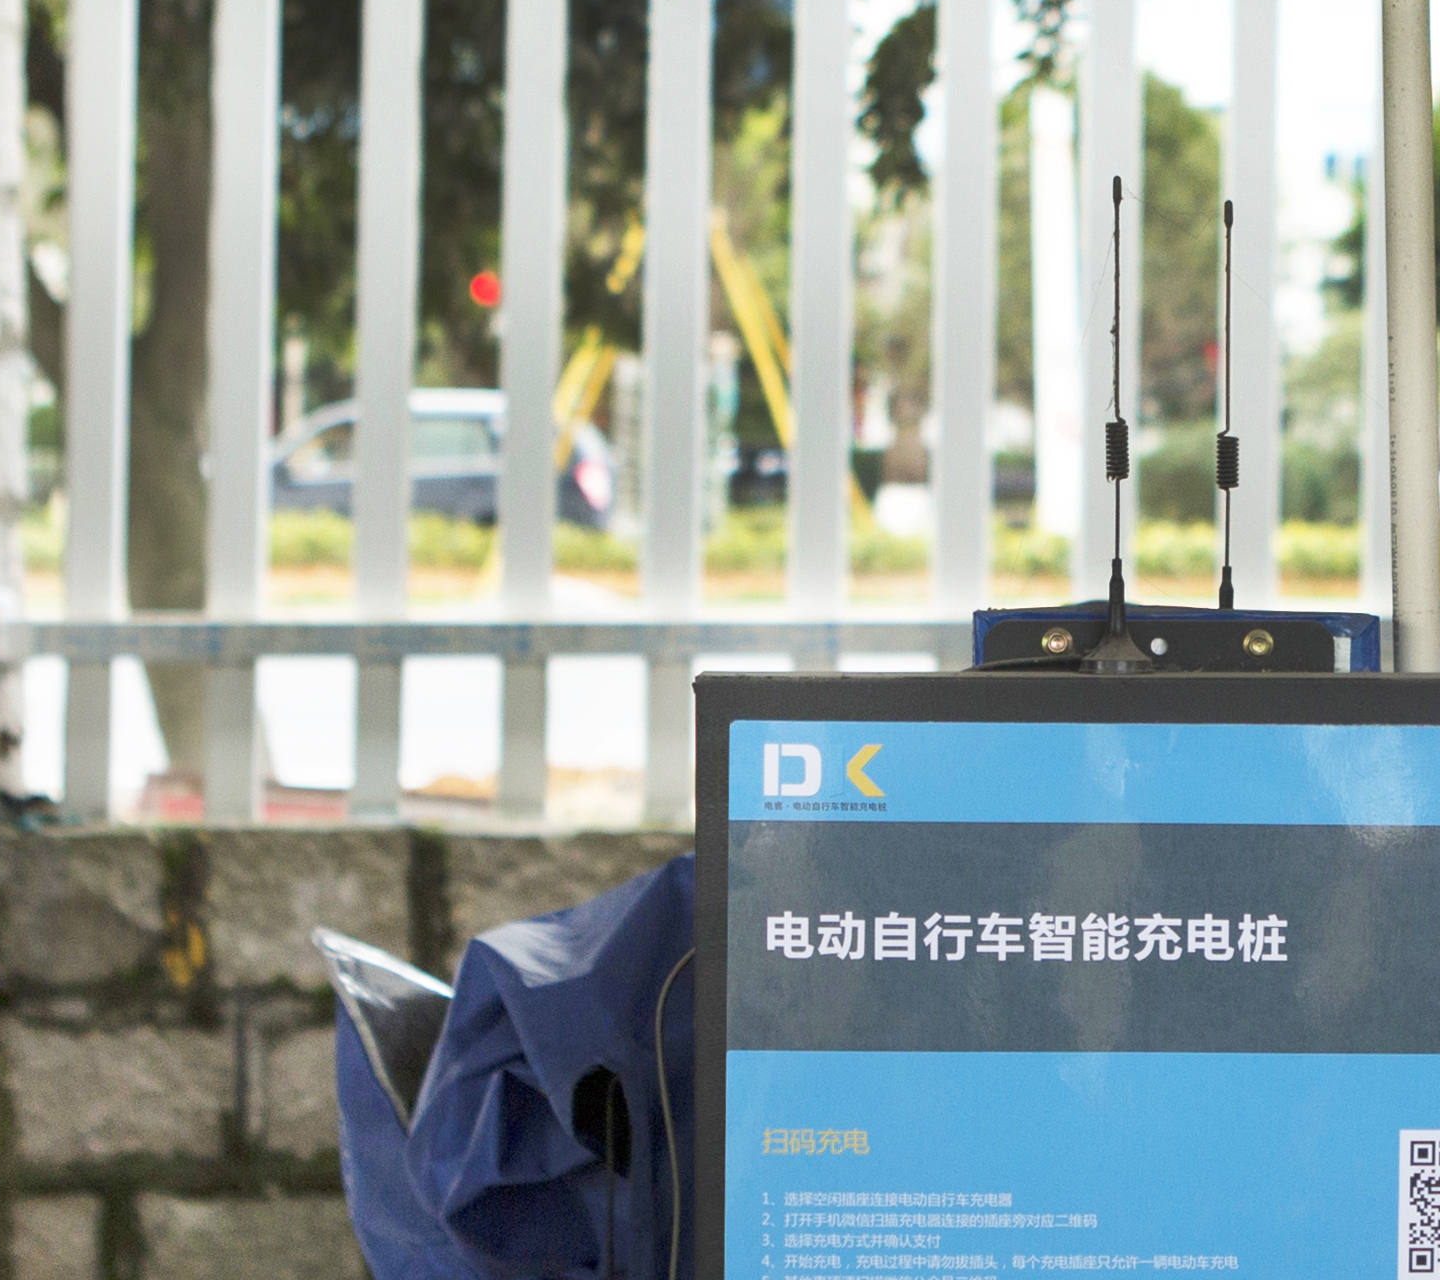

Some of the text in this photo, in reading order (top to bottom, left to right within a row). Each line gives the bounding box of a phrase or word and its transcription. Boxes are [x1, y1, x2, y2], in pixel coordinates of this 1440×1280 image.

[765, 911, 1288, 964] 电动自行车智能充电桩
[762, 1127, 870, 1155] 扫码充电
